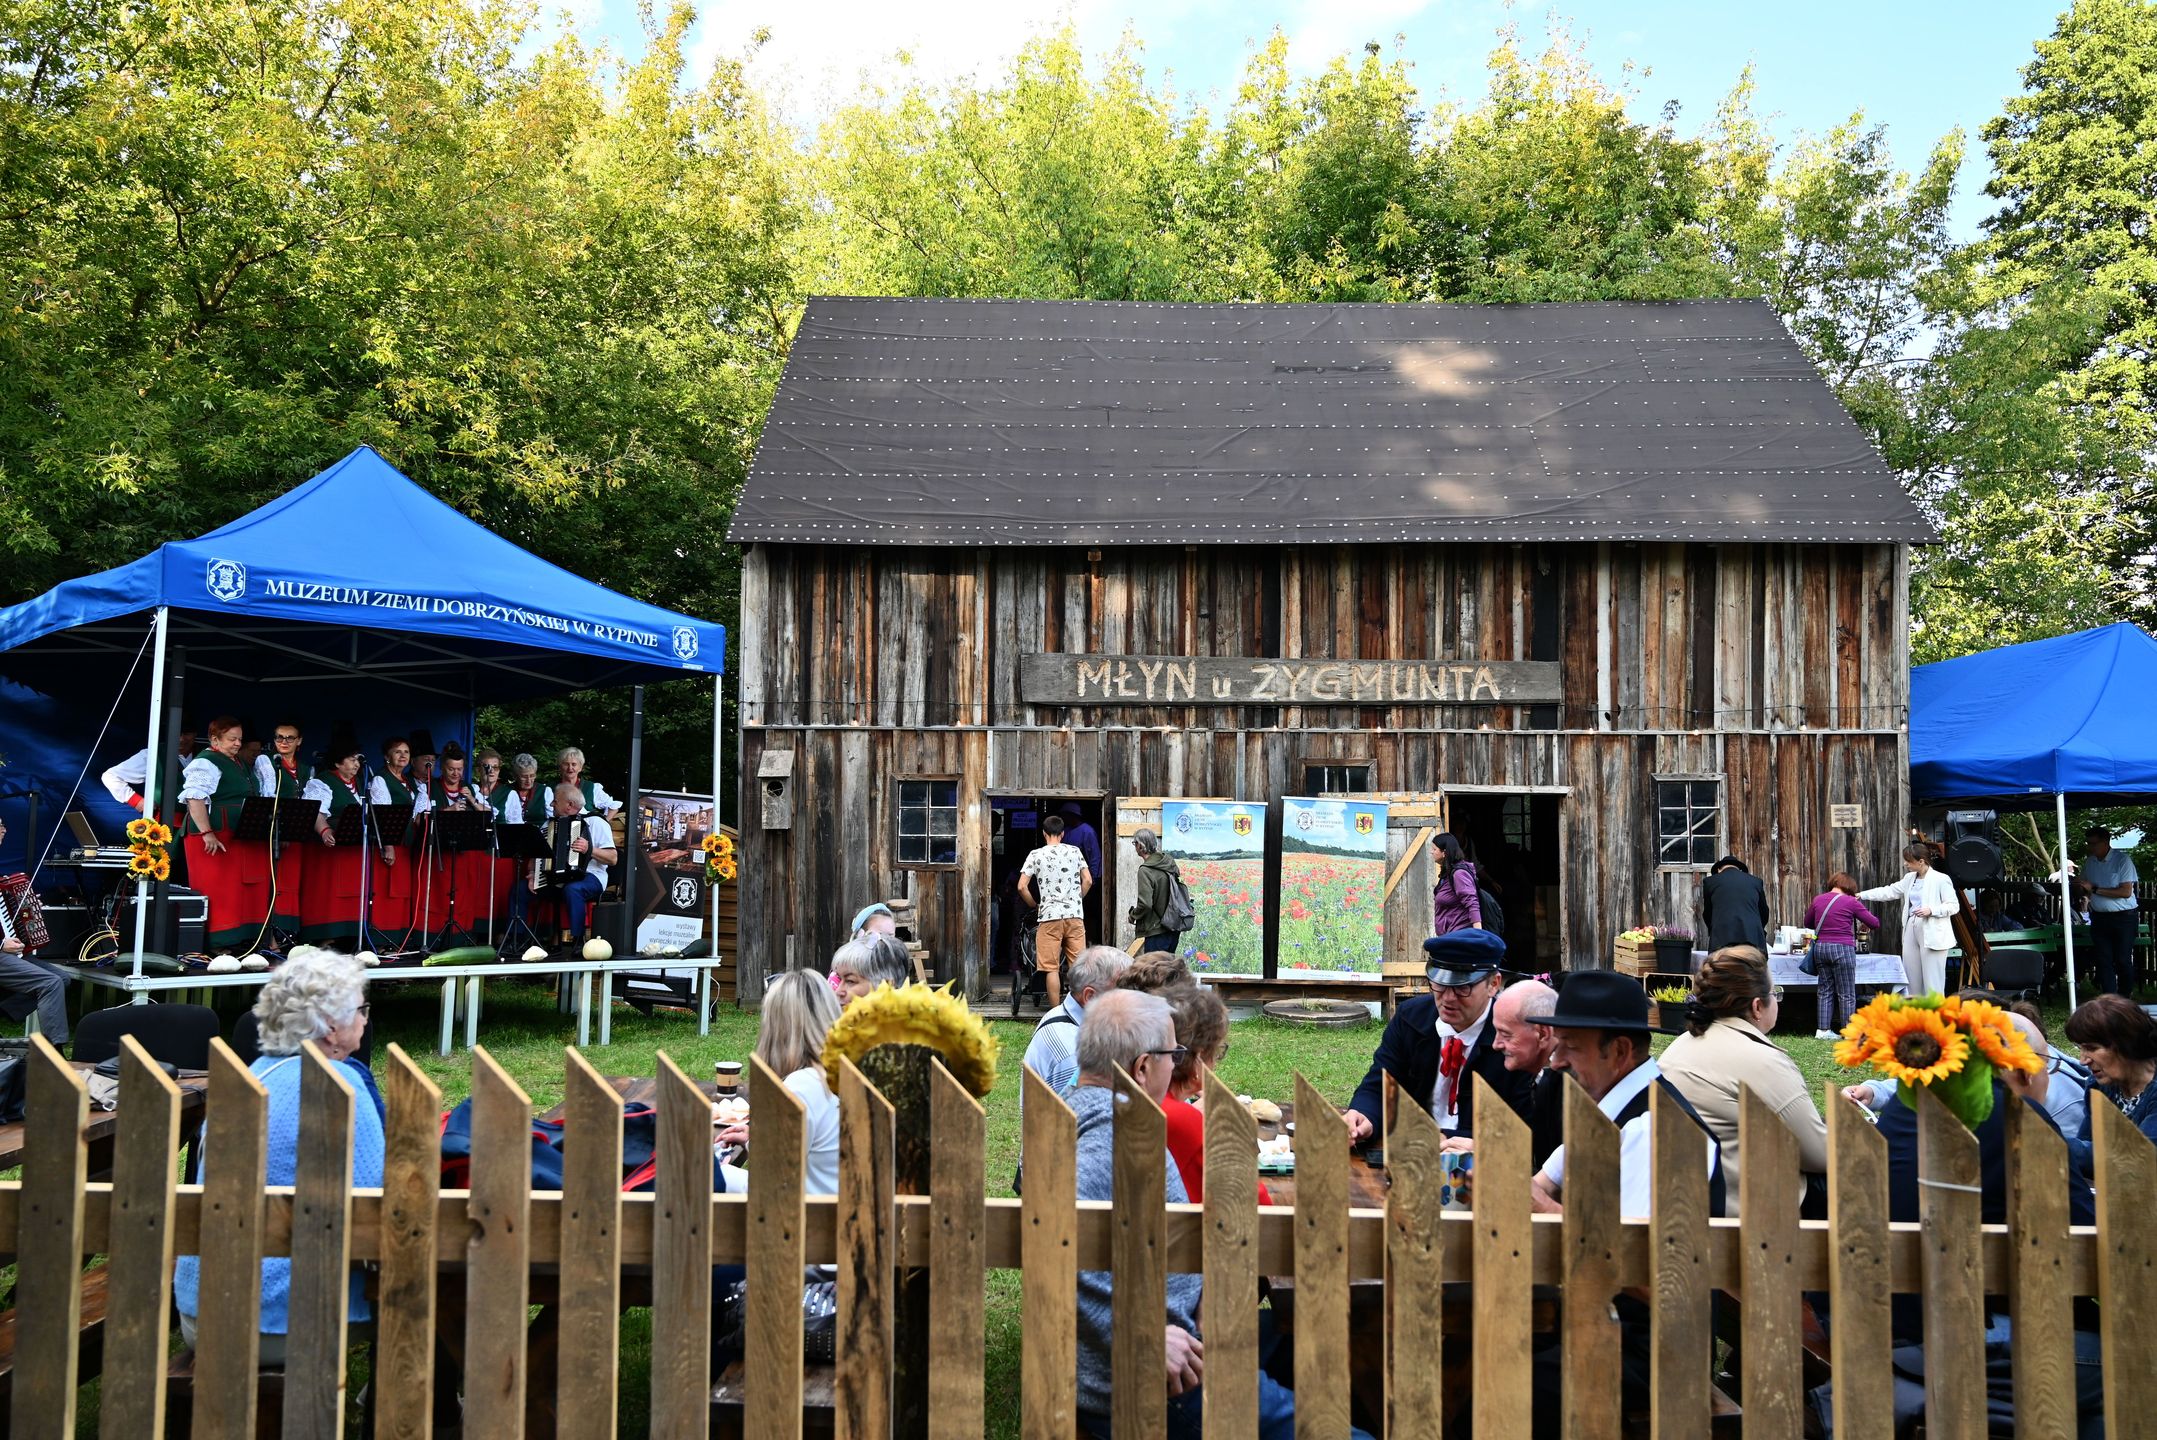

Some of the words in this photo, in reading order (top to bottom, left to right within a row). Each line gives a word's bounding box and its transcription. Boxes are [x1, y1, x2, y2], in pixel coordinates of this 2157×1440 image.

[264, 579, 369, 605] MUZEUM
[371, 591, 429, 612] ZIEMI
[433, 598, 568, 634] DOBRZYŃSKIEJ
[573, 621, 591, 635] W
[594, 624, 659, 648] RYPINIE
[1076, 658, 1197, 702] MŁYN
[1212, 676, 1232, 698] u
[1250, 663, 1501, 702] ZYGMUNTA
